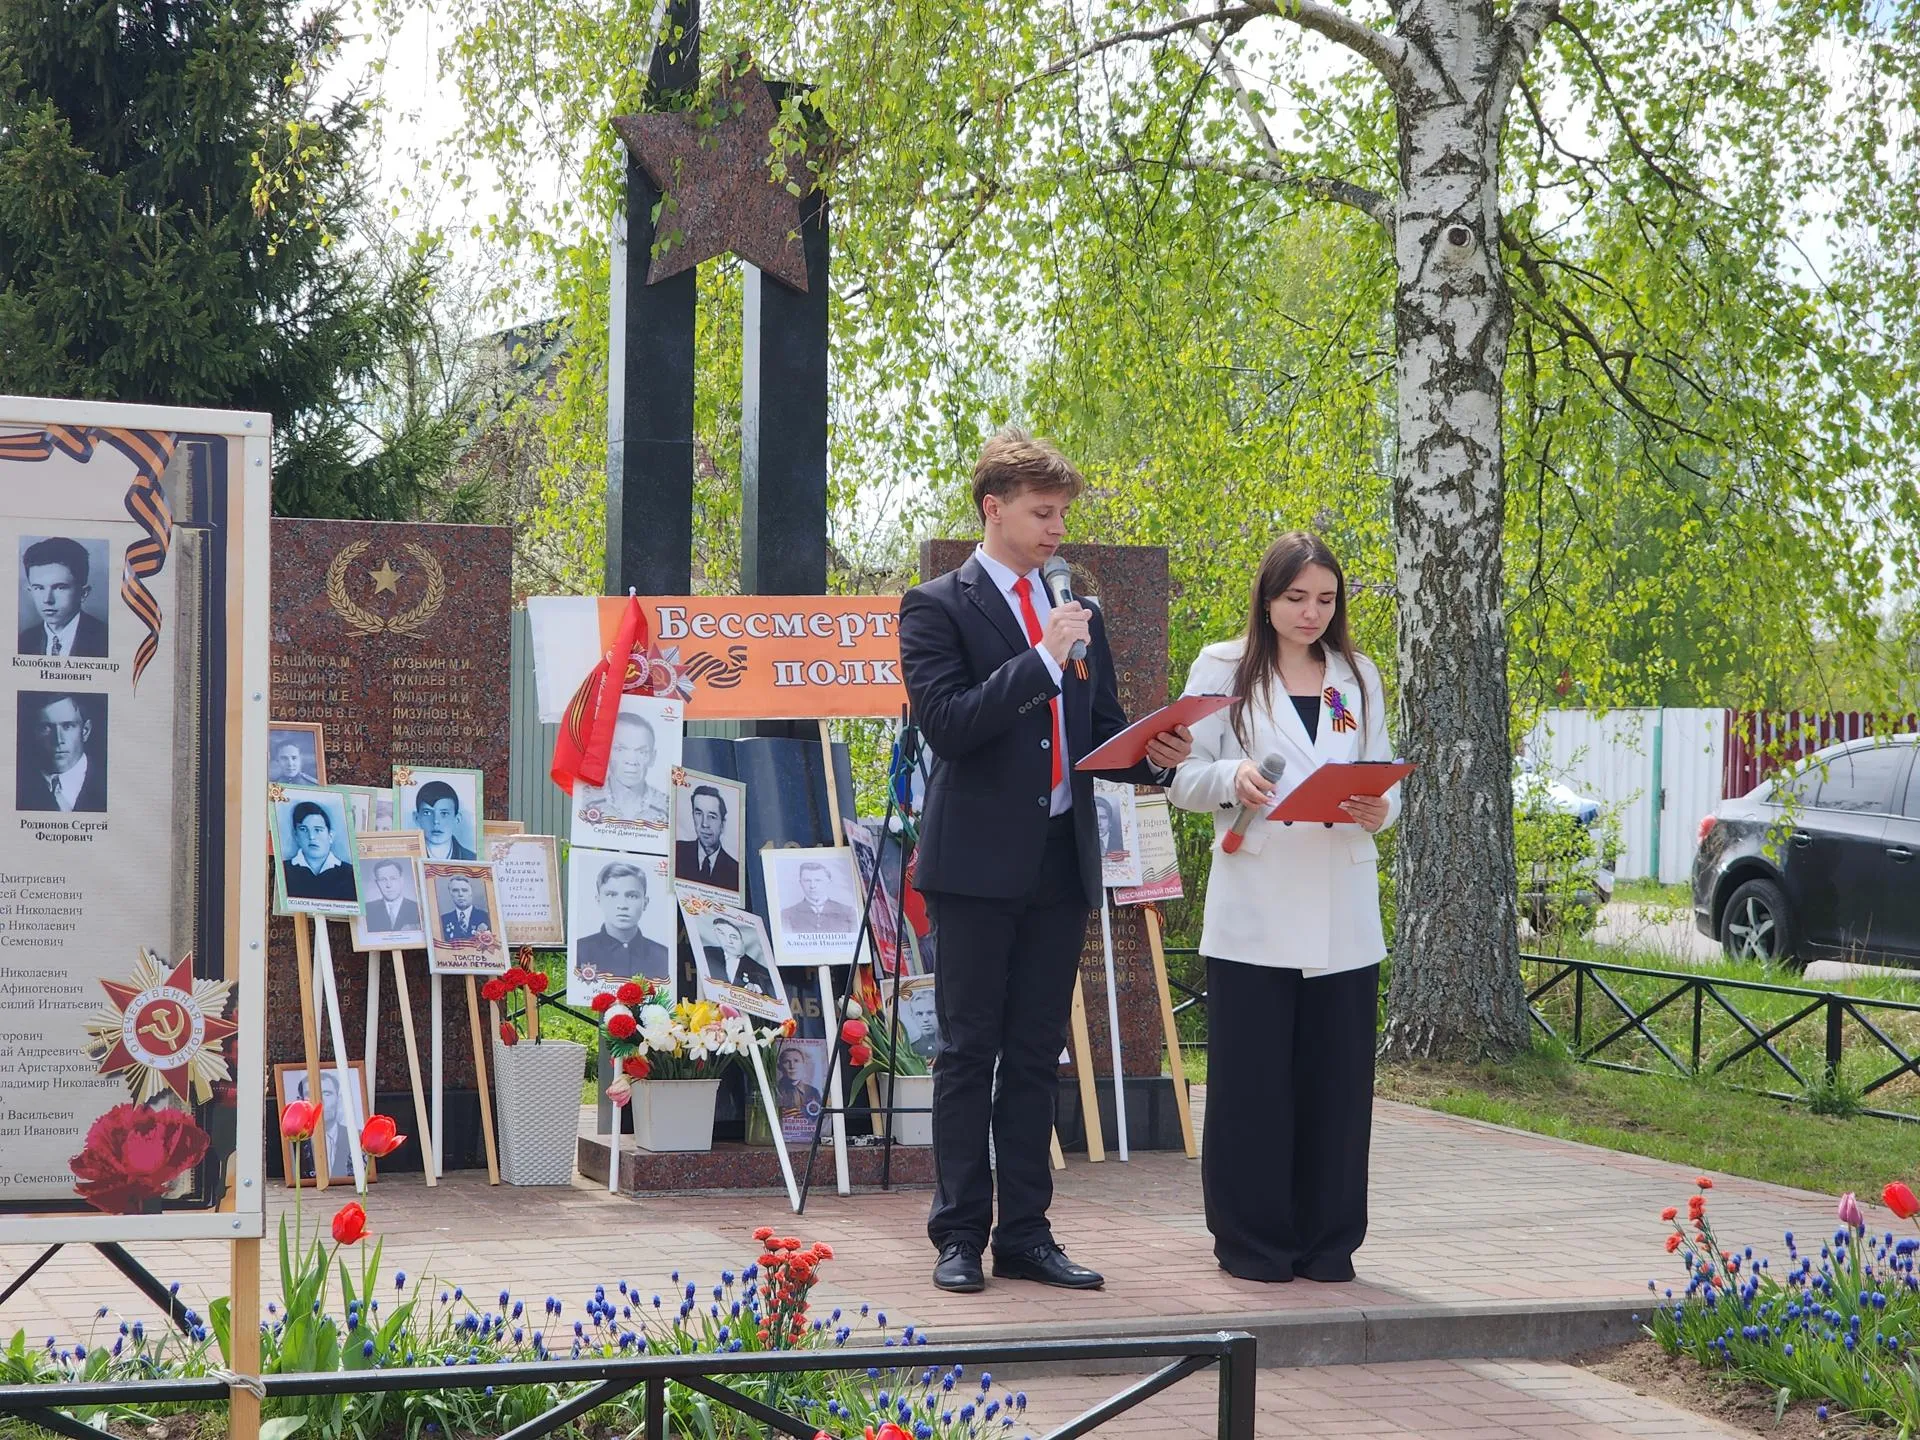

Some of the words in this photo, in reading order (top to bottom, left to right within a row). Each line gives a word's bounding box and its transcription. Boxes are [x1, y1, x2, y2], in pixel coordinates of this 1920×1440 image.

[12, 657, 62, 669] Колобков
[63, 659, 120, 672] Александр
[271, 655, 325, 667] БАШКИН
[393, 657, 445, 669] КУЗЬКИН
[40, 670, 92, 681] Иванович
[271, 672, 325, 684] БАШКИН
[773, 660, 902, 686] полк
[393, 675, 445, 686] КУКЛАЕВ
[392, 692, 446, 703] КУЛАГИН
[392, 709, 448, 720] ЛИЗУНОВ
[392, 725, 459, 736] МАКСИМОВ
[20, 819, 70, 832] Родионов
[71, 820, 108, 832] Сергей
[35, 831, 93, 843] Федорович
[20, 888, 83, 900] Семенович
[16, 904, 83, 916] Николаевич
[8, 920, 76, 931] Николаевич
[0, 935, 64, 947] Семенович
[452, 954, 487, 962] ТОЛСТОВ
[0, 967, 68, 978] Николаевич
[0, 983, 84, 996] Афиногенович
[38, 999, 104, 1010] Игнатьевич
[124, 988, 202, 1053] ОТЕЧЕСТВЕННАЯ
[17, 1046, 79, 1058] Андреевич
[17, 1063, 98, 1075] Аристархович
[52, 1078, 120, 1088] Николаевич
[8, 1109, 74, 1120] Васильевич
[23, 1125, 79, 1136] Иванович
[13, 1173, 77, 1184] Семенович
